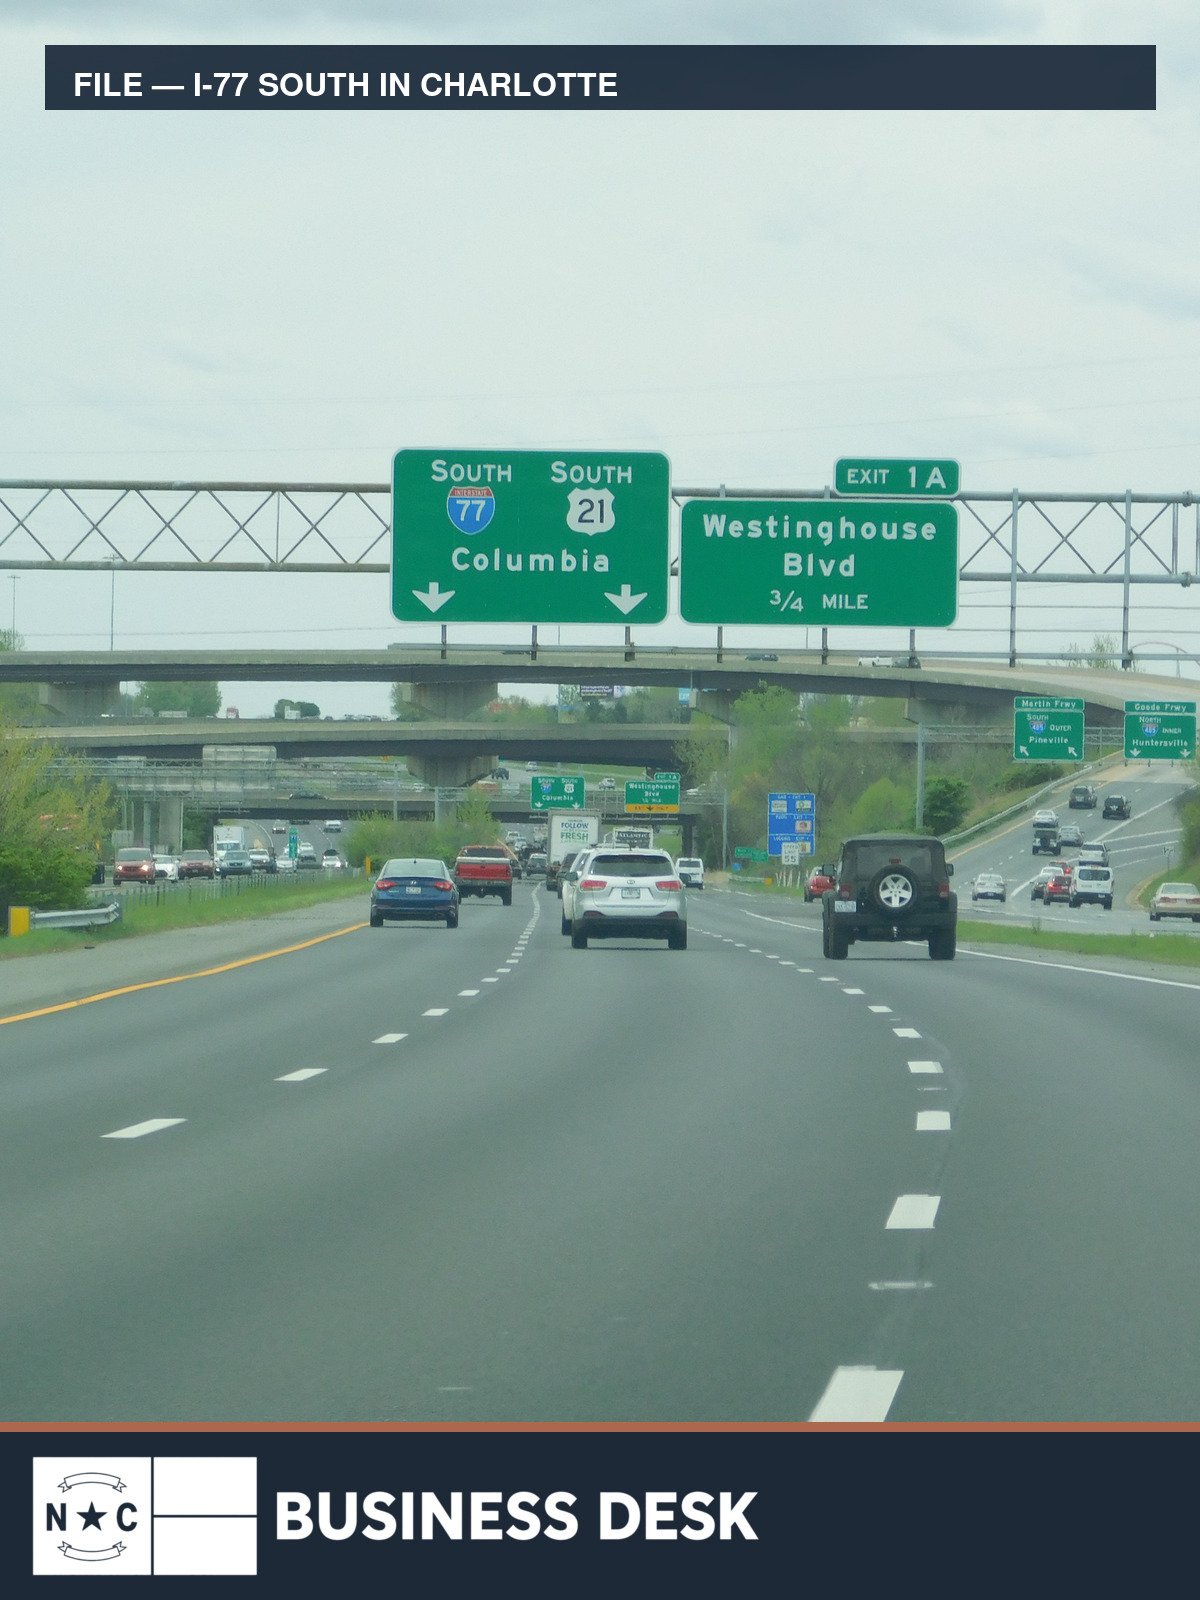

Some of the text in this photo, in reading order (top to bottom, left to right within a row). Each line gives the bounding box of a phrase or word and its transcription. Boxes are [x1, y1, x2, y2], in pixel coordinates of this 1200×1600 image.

[431, 459, 512, 483] SOUTH
[550, 460, 633, 484] SOUTH
[846, 468, 890, 485] EXIT
[453, 488, 488, 497] INTERSTATE
[456, 499, 486, 522] 77
[577, 498, 605, 524] 21
[702, 513, 937, 546] Westinghouse
[451, 546, 610, 573] Columbia
[783, 552, 856, 577] Blvd
[822, 593, 869, 610] MILE
[1021, 699, 1076, 709] Martin Frwy
[1134, 703, 1187, 712] Goode Frwy
[1026, 713, 1049, 721] SOUTH
[1139, 716, 1162, 724] NORTH
[1049, 724, 1072, 732] OUTER
[1028, 736, 1069, 744] Pineville
[1132, 739, 1189, 747] Huntersville
[560, 832, 589, 841] FRESH
